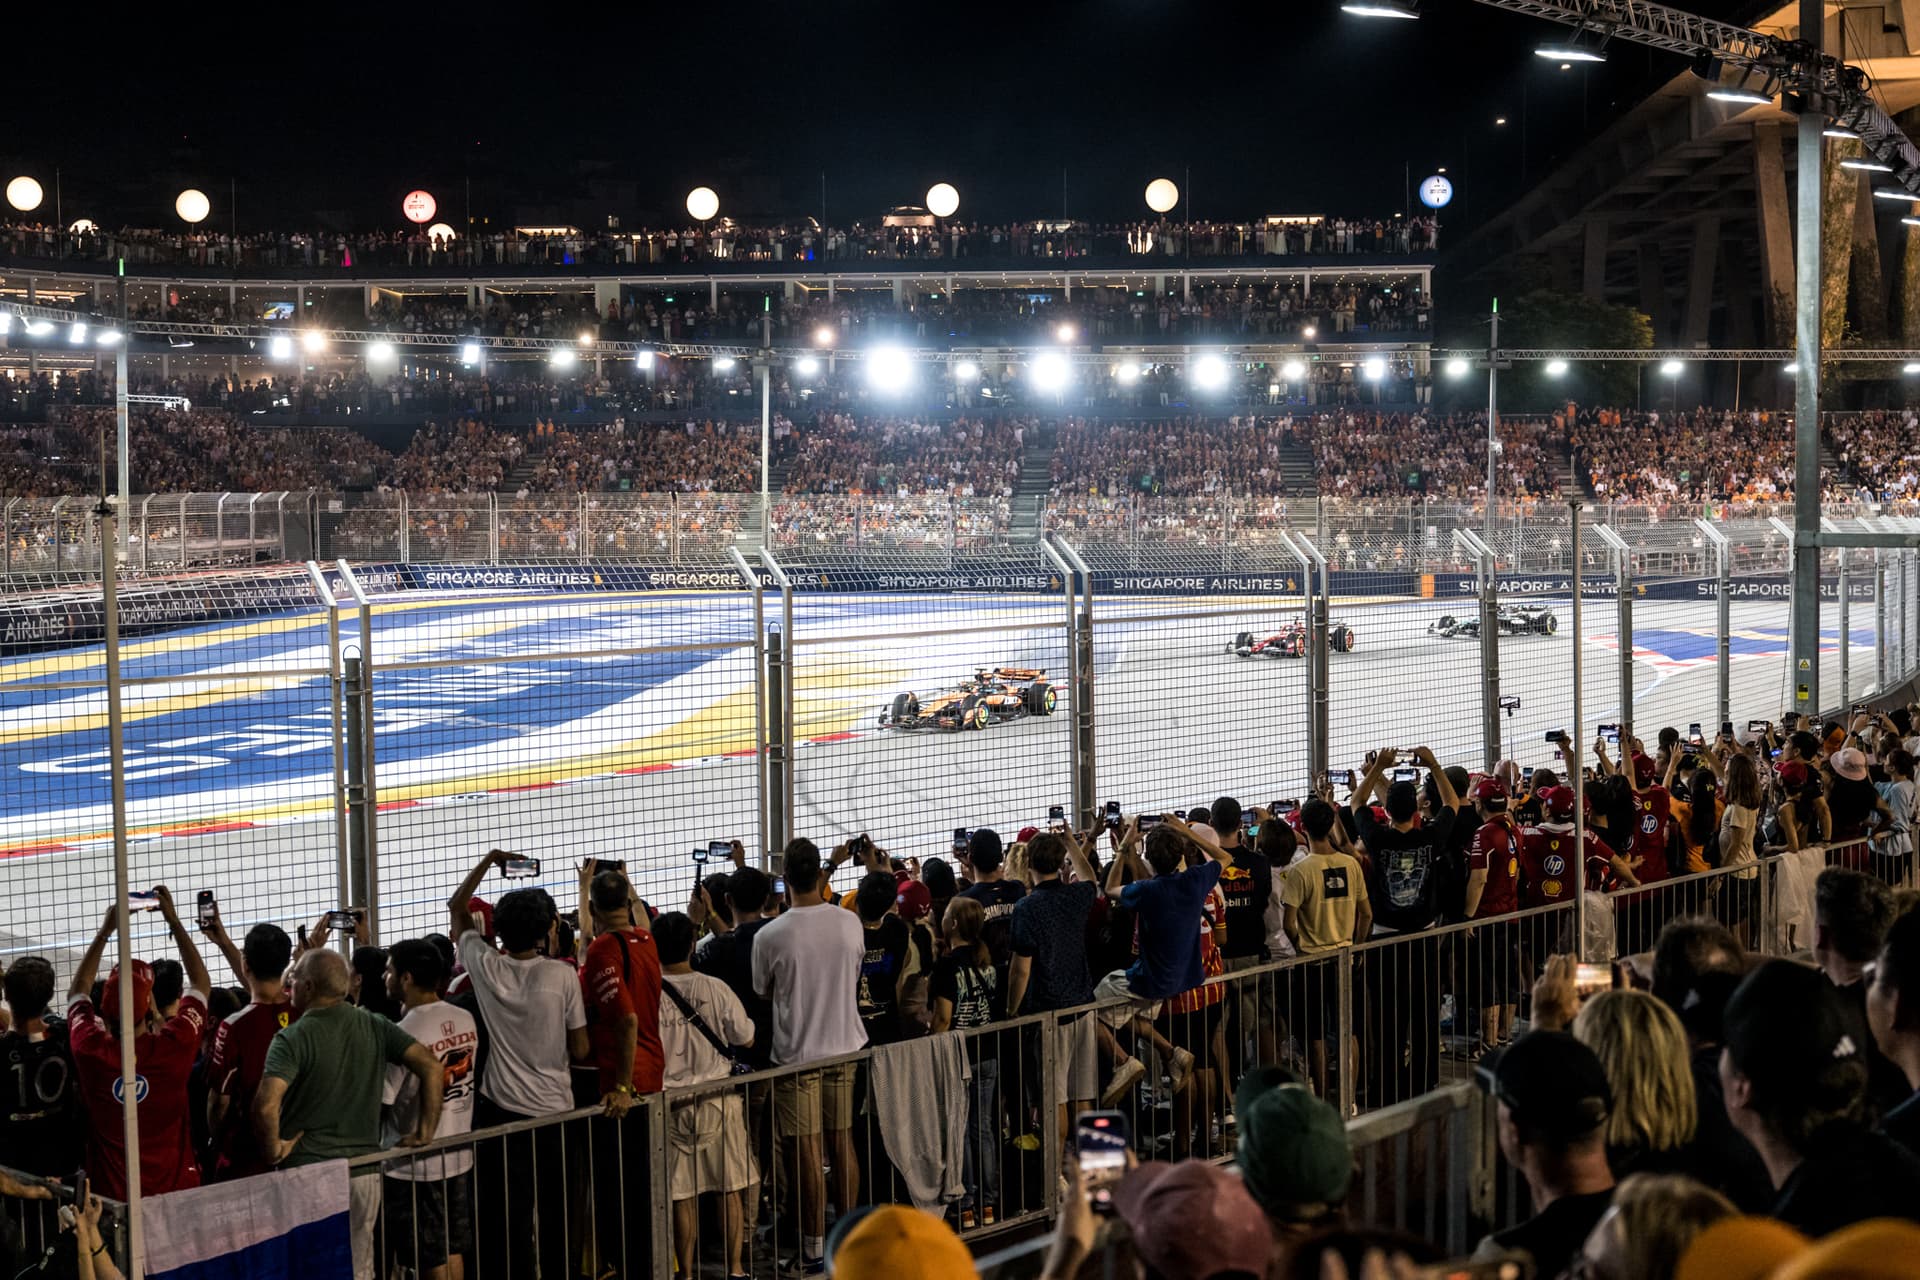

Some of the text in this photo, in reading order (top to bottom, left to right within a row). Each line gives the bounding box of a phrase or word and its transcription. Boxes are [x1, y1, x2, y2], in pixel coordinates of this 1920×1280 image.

[426, 572, 590, 584] SINGAPORE AIRLINES
[650, 573, 740, 585] SINGAPORE
[878, 576, 1047, 588] SINGAPORE AIRLINES
[1114, 578, 1283, 590] SINGAPORE AIRLINES
[5, 616, 65, 642] AIRLINES
[1546, 855, 1562, 876] hp
[10, 1056, 68, 1108] 10
